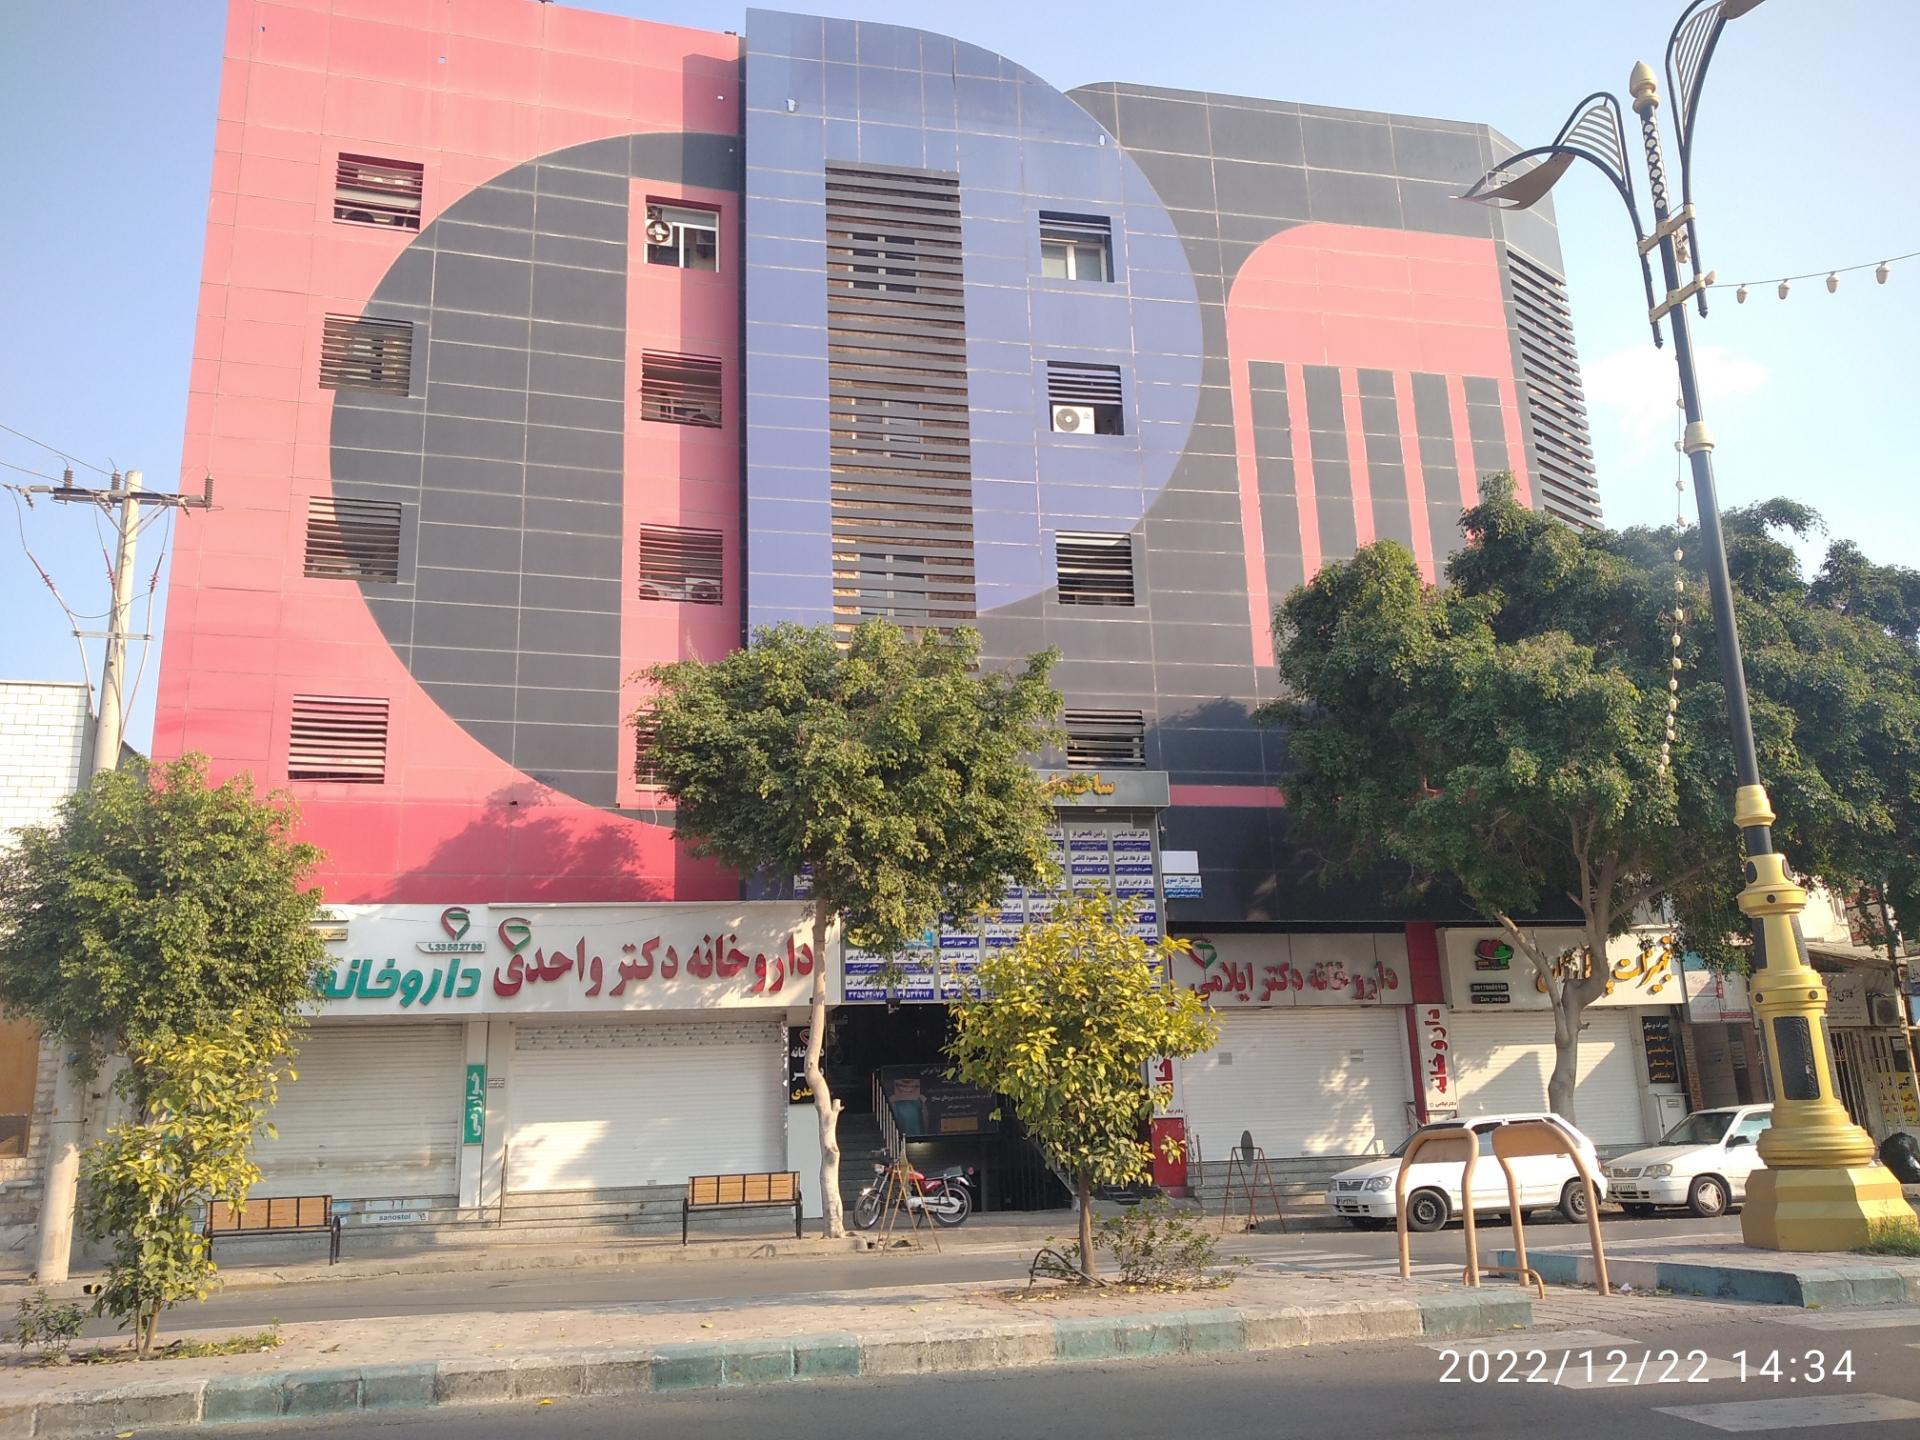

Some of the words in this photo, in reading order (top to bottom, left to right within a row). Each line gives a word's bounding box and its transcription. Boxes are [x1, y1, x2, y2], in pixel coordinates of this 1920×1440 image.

[493, 936, 604, 998] واحدی
[609, 935, 679, 997] دکتر
[686, 933, 815, 995] داروخانه
[1260, 960, 1304, 1002] دکتر
[1309, 960, 1399, 1001] داروخانه
[1423, 1008, 1449, 1094] داروخانه
